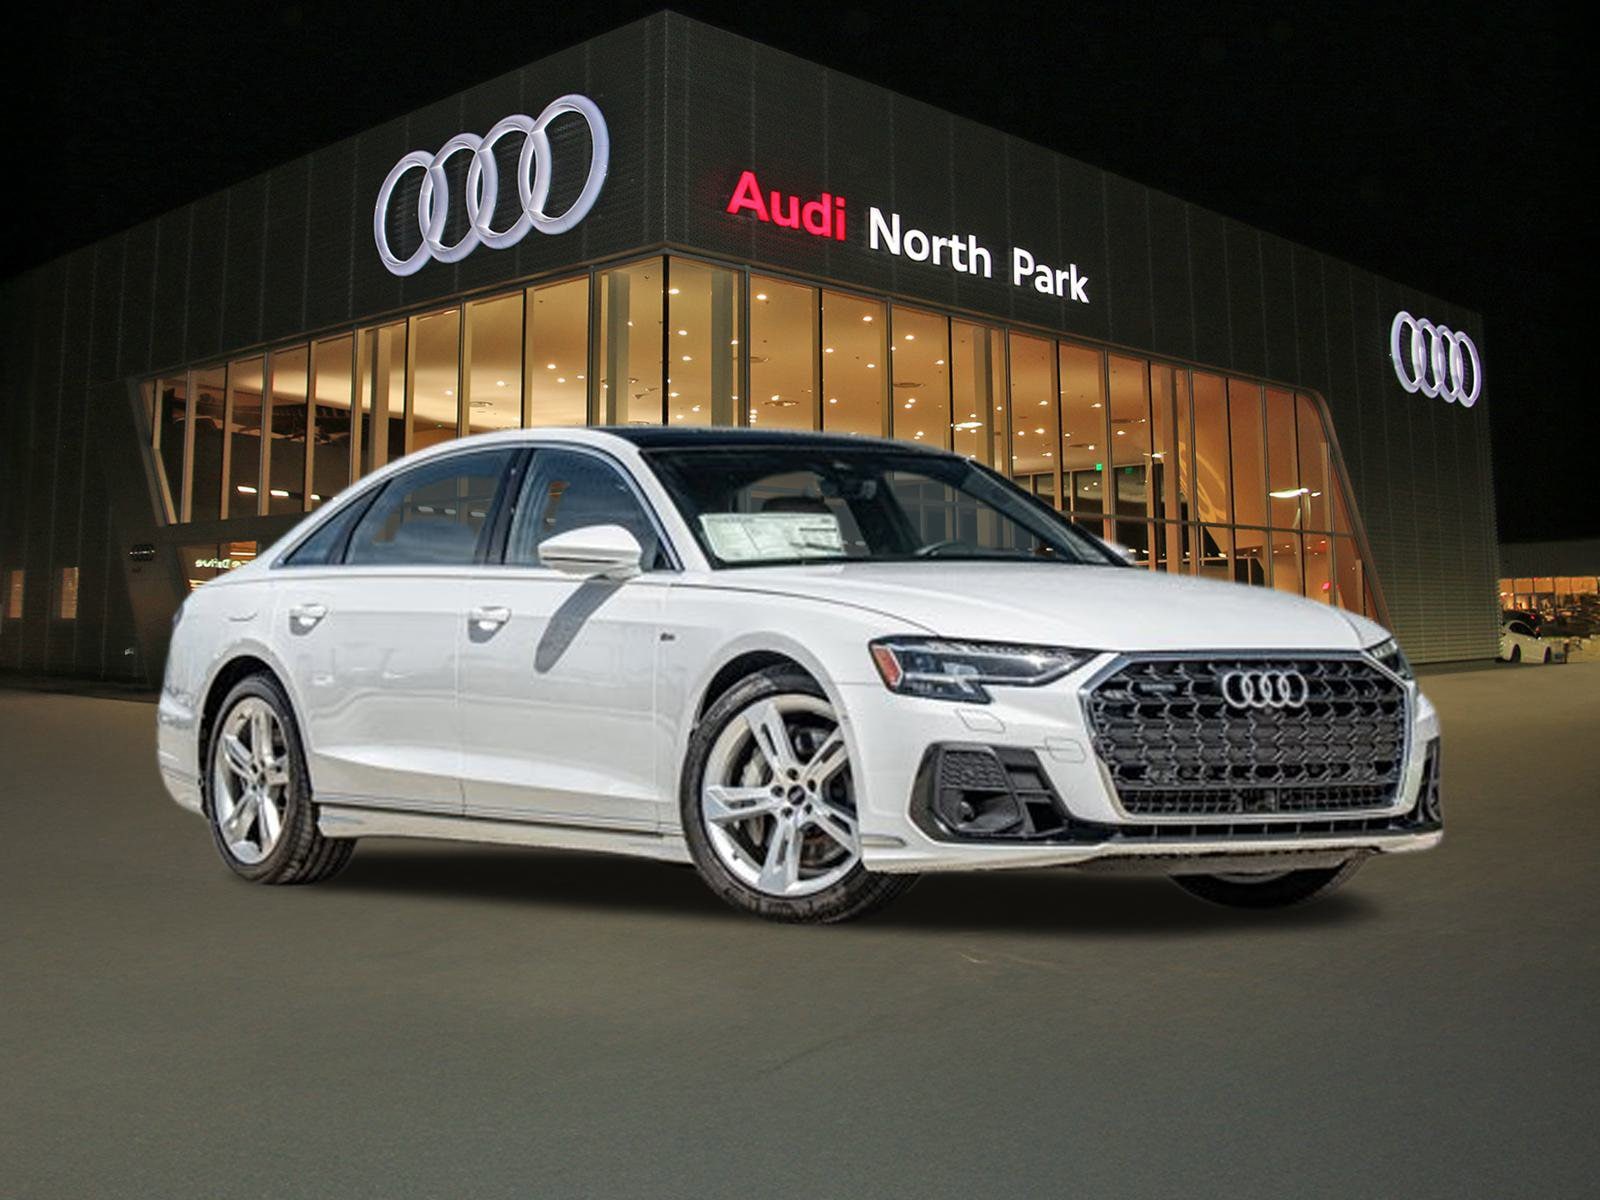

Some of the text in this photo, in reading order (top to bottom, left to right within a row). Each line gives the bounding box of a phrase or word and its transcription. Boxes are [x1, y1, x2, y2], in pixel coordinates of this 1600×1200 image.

[726, 171, 1090, 304] Audi North Park
